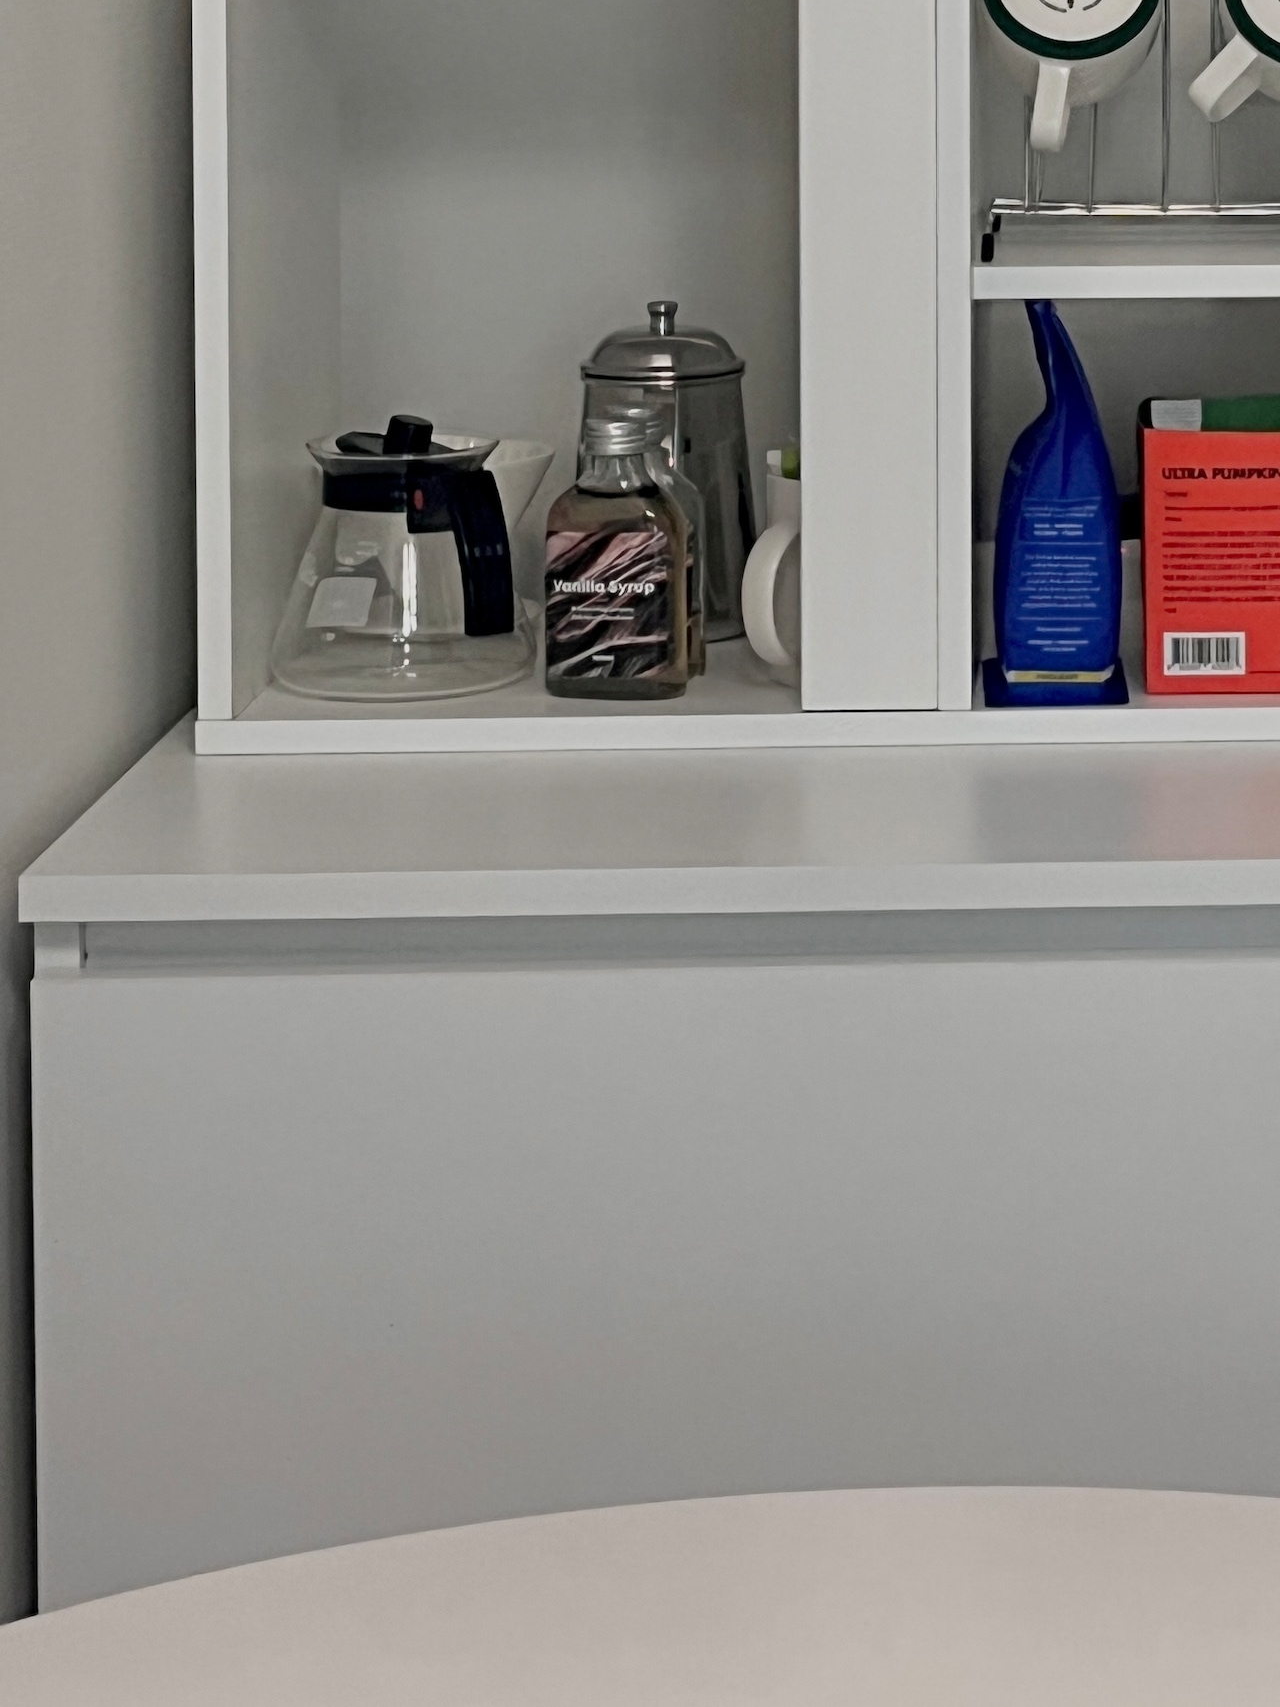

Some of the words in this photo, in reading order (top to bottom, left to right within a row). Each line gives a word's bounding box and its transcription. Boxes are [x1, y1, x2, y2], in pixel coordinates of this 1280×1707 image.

[1161, 467, 1208, 480] ULTRA
[553, 579, 606, 594] Vanilla
[607, 580, 655, 596] Syrup
